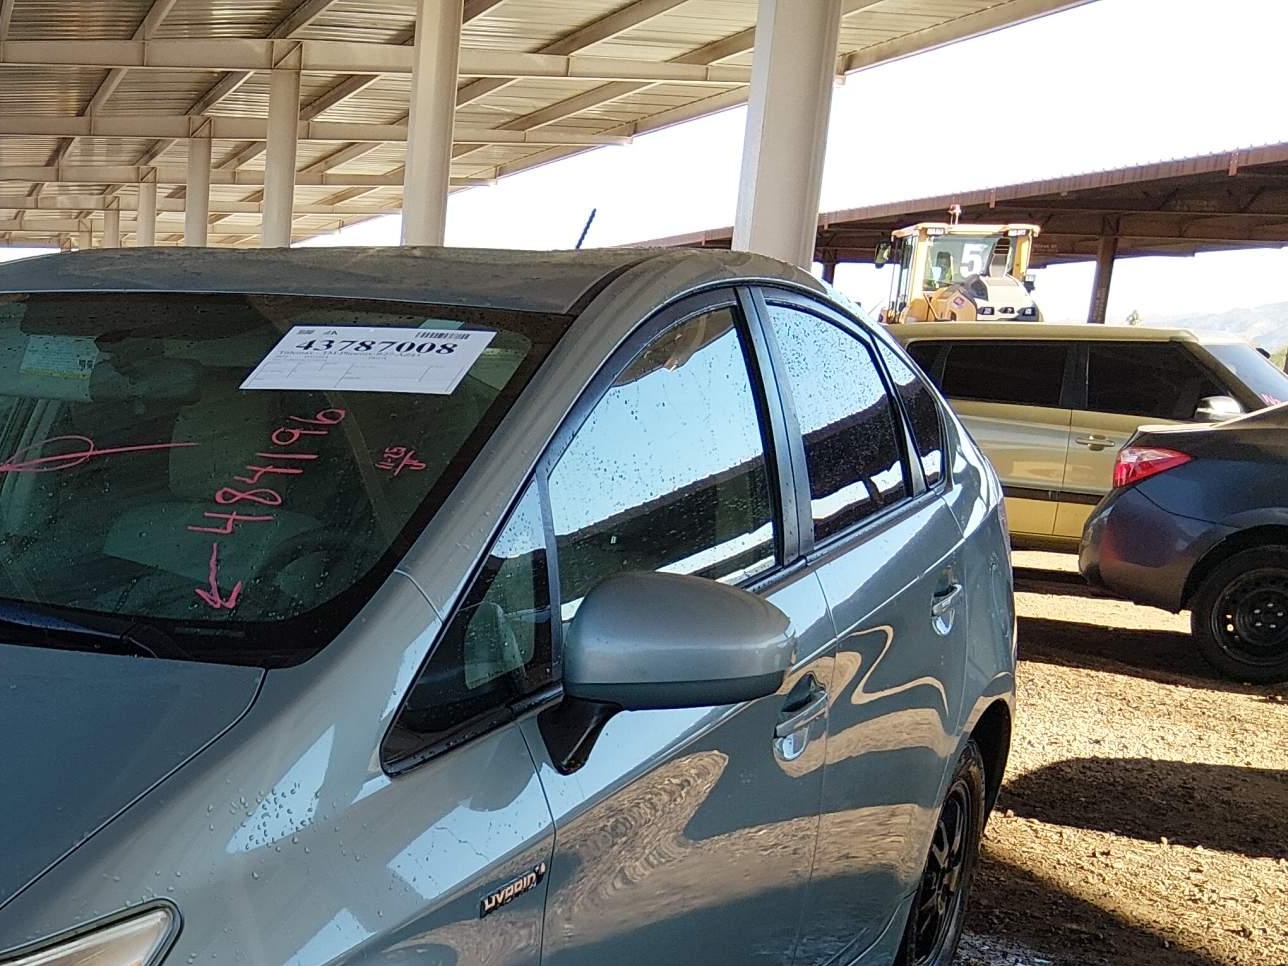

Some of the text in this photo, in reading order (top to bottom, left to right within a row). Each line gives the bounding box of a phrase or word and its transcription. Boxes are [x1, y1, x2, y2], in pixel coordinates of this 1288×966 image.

[960, 243, 987, 278] 5
[295, 337, 458, 355] 43787008
[187, 407, 347, 535] 484196
